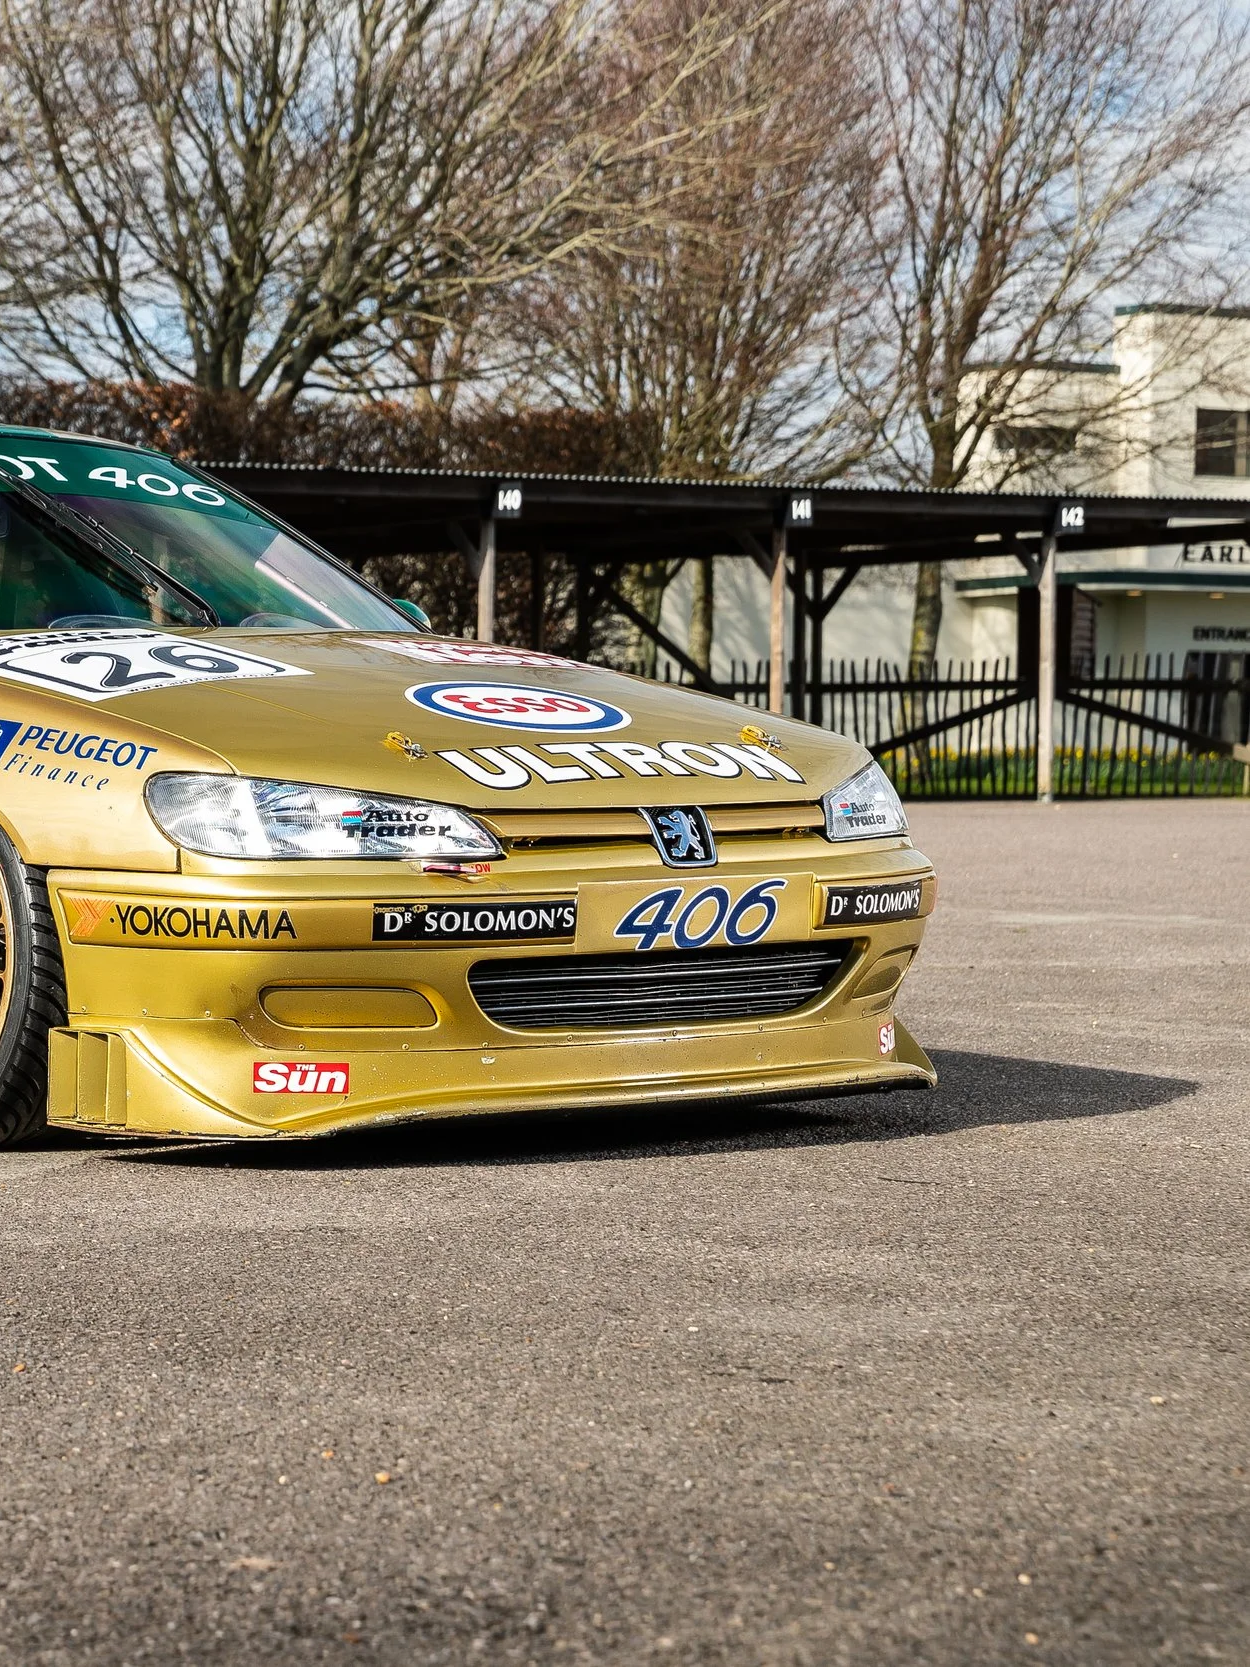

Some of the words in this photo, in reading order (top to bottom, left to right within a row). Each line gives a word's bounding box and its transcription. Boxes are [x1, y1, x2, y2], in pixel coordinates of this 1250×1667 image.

[88, 466, 226, 507] 406
[498, 489, 522, 511] 140
[1061, 506, 1085, 527] 142
[61, 646, 240, 689] 26
[17, 725, 159, 771] PEUGEOT
[4, 752, 110, 791] Finance
[434, 740, 808, 791] ULTRON
[362, 810, 429, 823] Auto
[846, 813, 887, 828] Trader
[850, 802, 875, 814] Auto
[342, 823, 452, 838] Trader
[614, 877, 789, 951] 406
[854, 888, 920, 915] SOLOMON'S
[115, 903, 298, 940] YOKOHAMA
[424, 907, 575, 933] SOLOMON'S
[254, 1063, 347, 1093] Sun
[295, 1063, 316, 1071] THE
